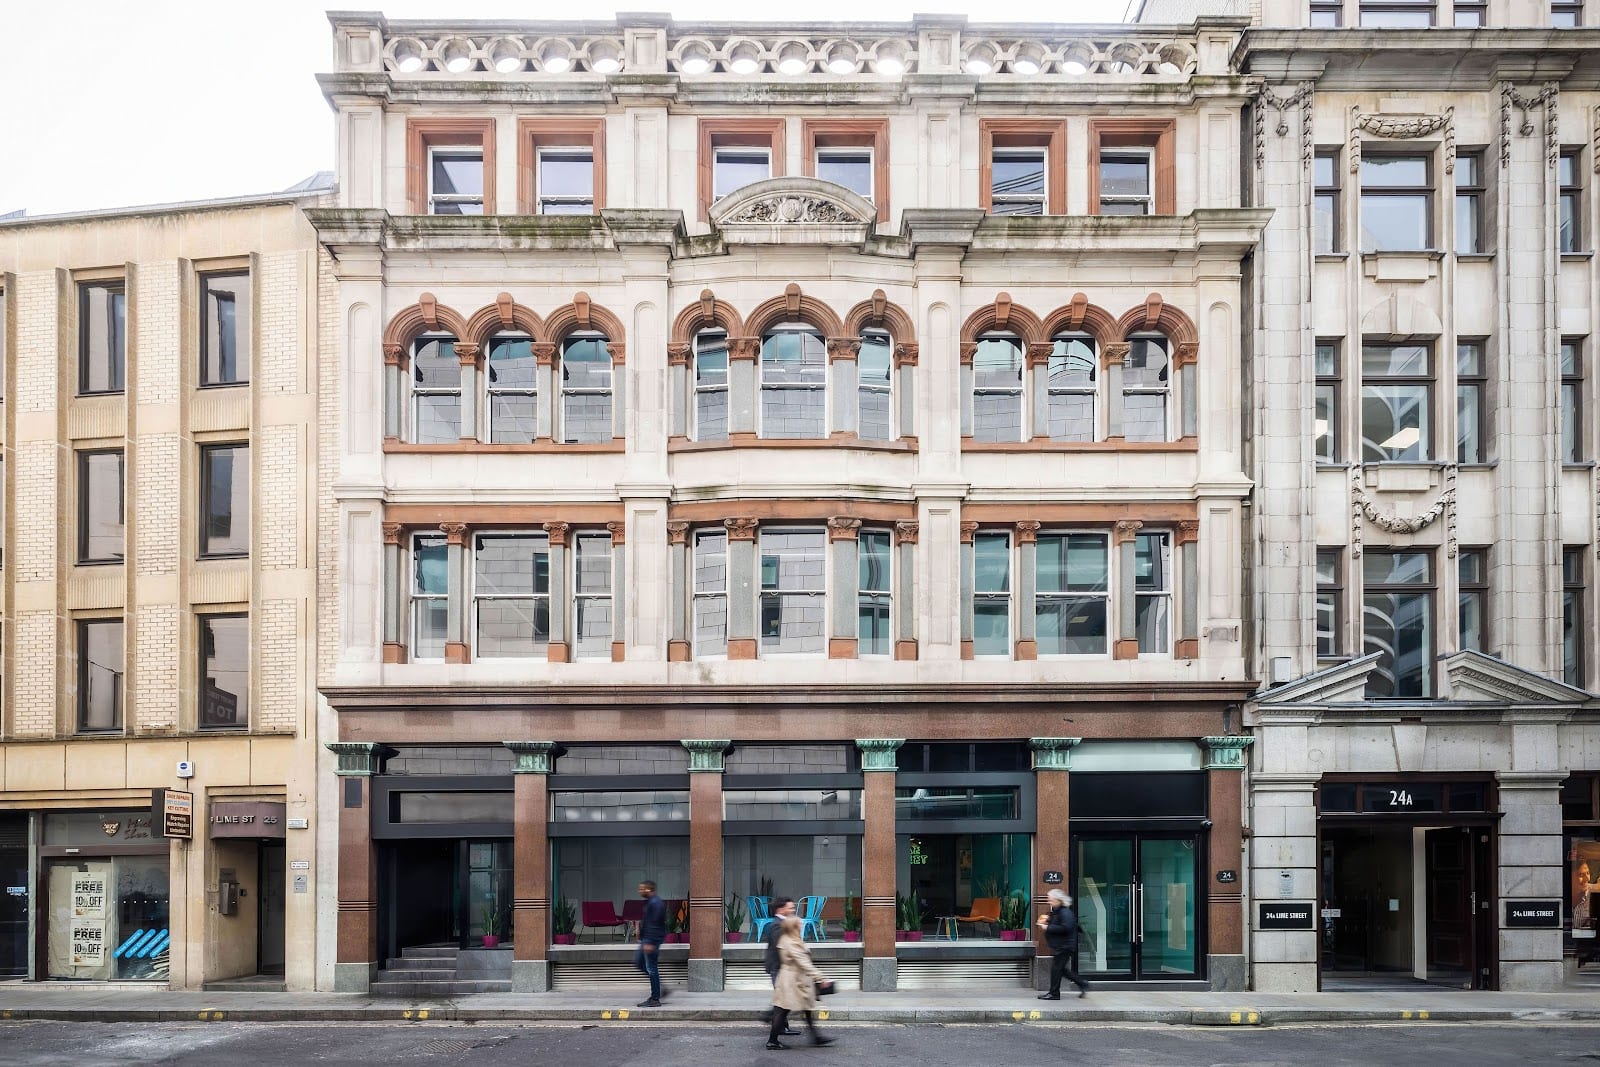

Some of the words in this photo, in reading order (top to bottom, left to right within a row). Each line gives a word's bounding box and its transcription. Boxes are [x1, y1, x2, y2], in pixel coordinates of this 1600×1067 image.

[1389, 790, 1413, 805] 24A
[216, 815, 239, 824] LIME
[241, 815, 255, 823] ST
[263, 815, 278, 824] 25
[75, 883, 103, 891] FREE
[90, 896, 103, 906] OFF
[74, 931, 102, 939] FREE
[88, 943, 102, 953] OFF
